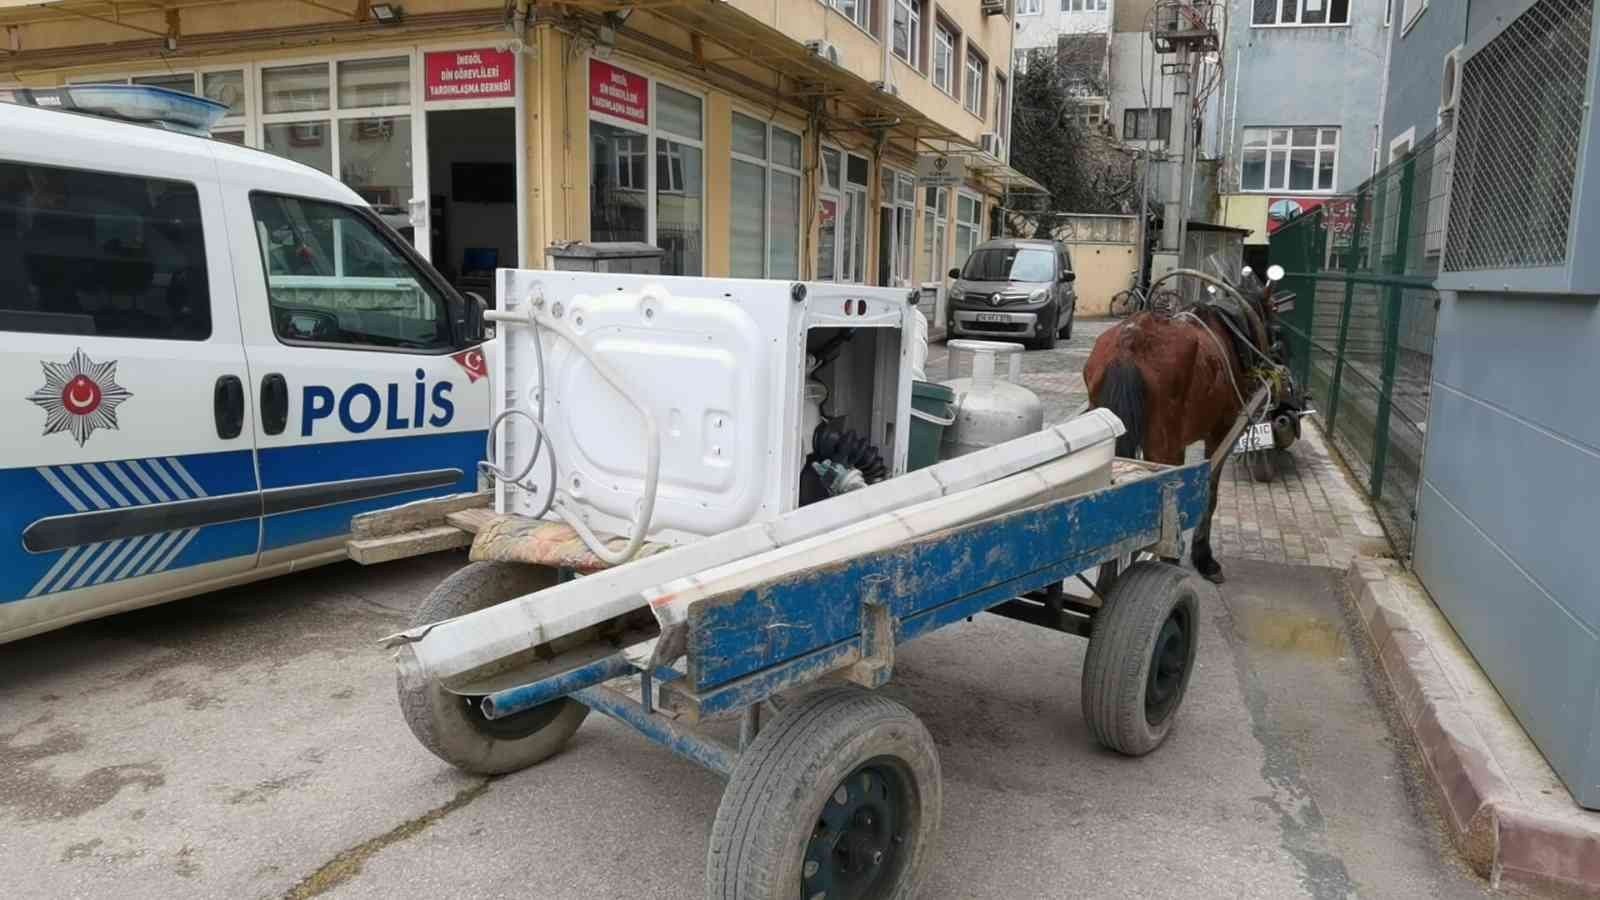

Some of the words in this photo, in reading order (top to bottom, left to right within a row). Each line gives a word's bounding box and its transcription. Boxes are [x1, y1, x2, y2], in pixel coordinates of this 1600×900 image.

[456, 52, 482, 65] İNEGÖL
[441, 68, 454, 81] DİN
[454, 65, 499, 80] GÖREVLİLERİ
[301, 367, 455, 437] POLİS
